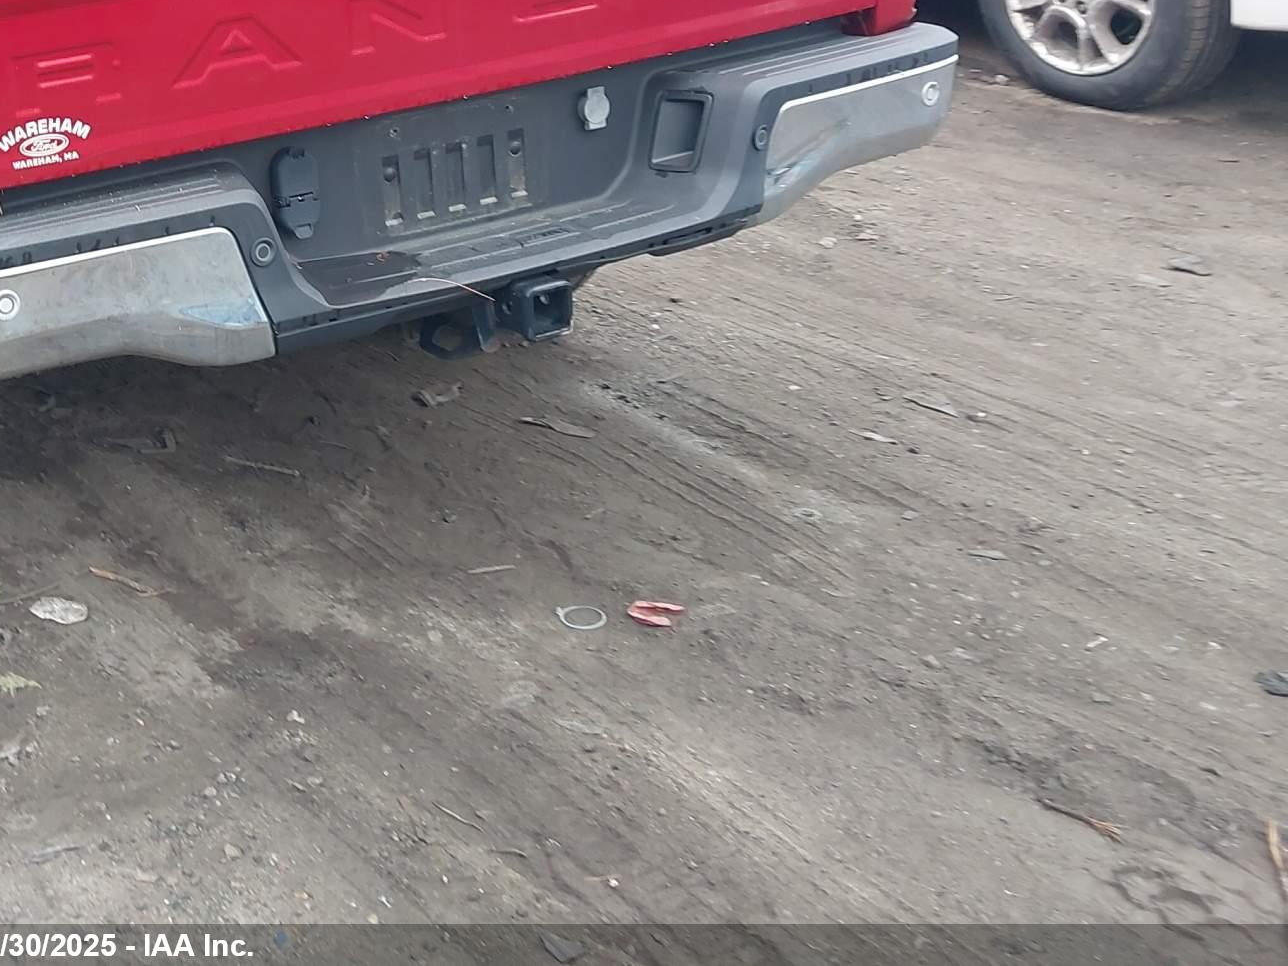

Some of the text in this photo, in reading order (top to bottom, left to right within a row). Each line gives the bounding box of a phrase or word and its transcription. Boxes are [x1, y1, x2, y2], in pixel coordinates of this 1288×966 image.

[30, 139, 58, 152] Ford
[13, 151, 79, 170] WAREHAM, MA
